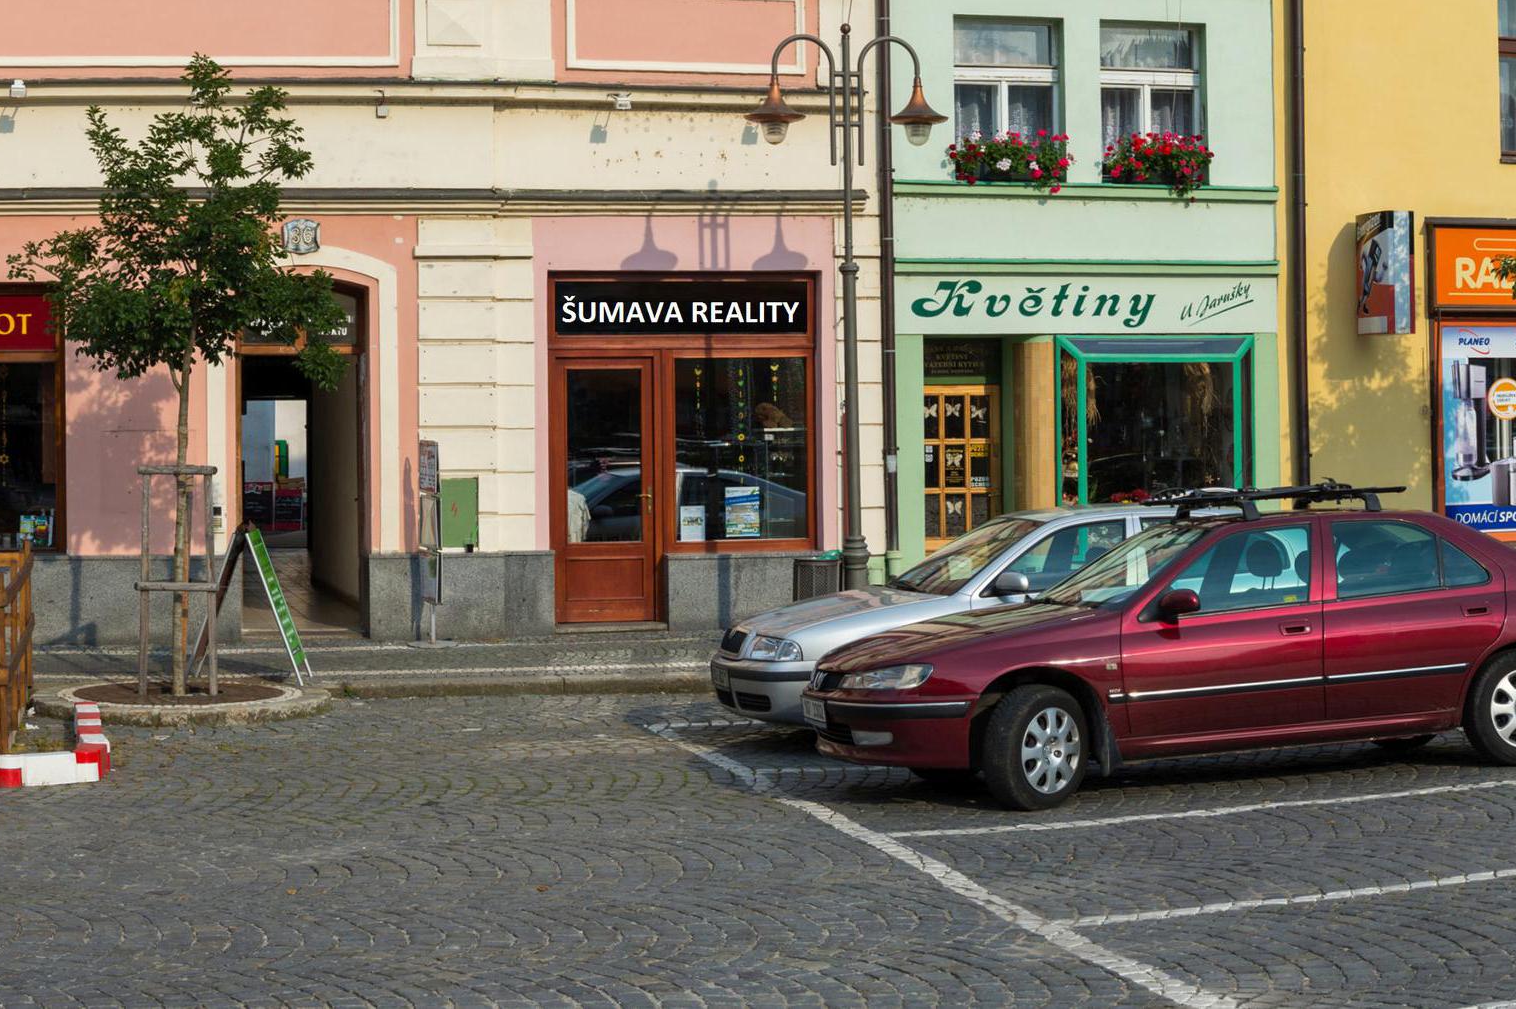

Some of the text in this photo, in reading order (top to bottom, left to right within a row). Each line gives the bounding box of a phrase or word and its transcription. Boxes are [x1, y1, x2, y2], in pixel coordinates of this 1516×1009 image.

[1455, 256, 1516, 289] RA
[561, 295, 800, 324] ŠUMAVA REALITY
[911, 279, 1156, 328] Květiny
[1195, 281, 1251, 318] Jarušky
[1458, 337, 1490, 346] PLANEO
[1455, 510, 1498, 524] DOMÁCÍ
